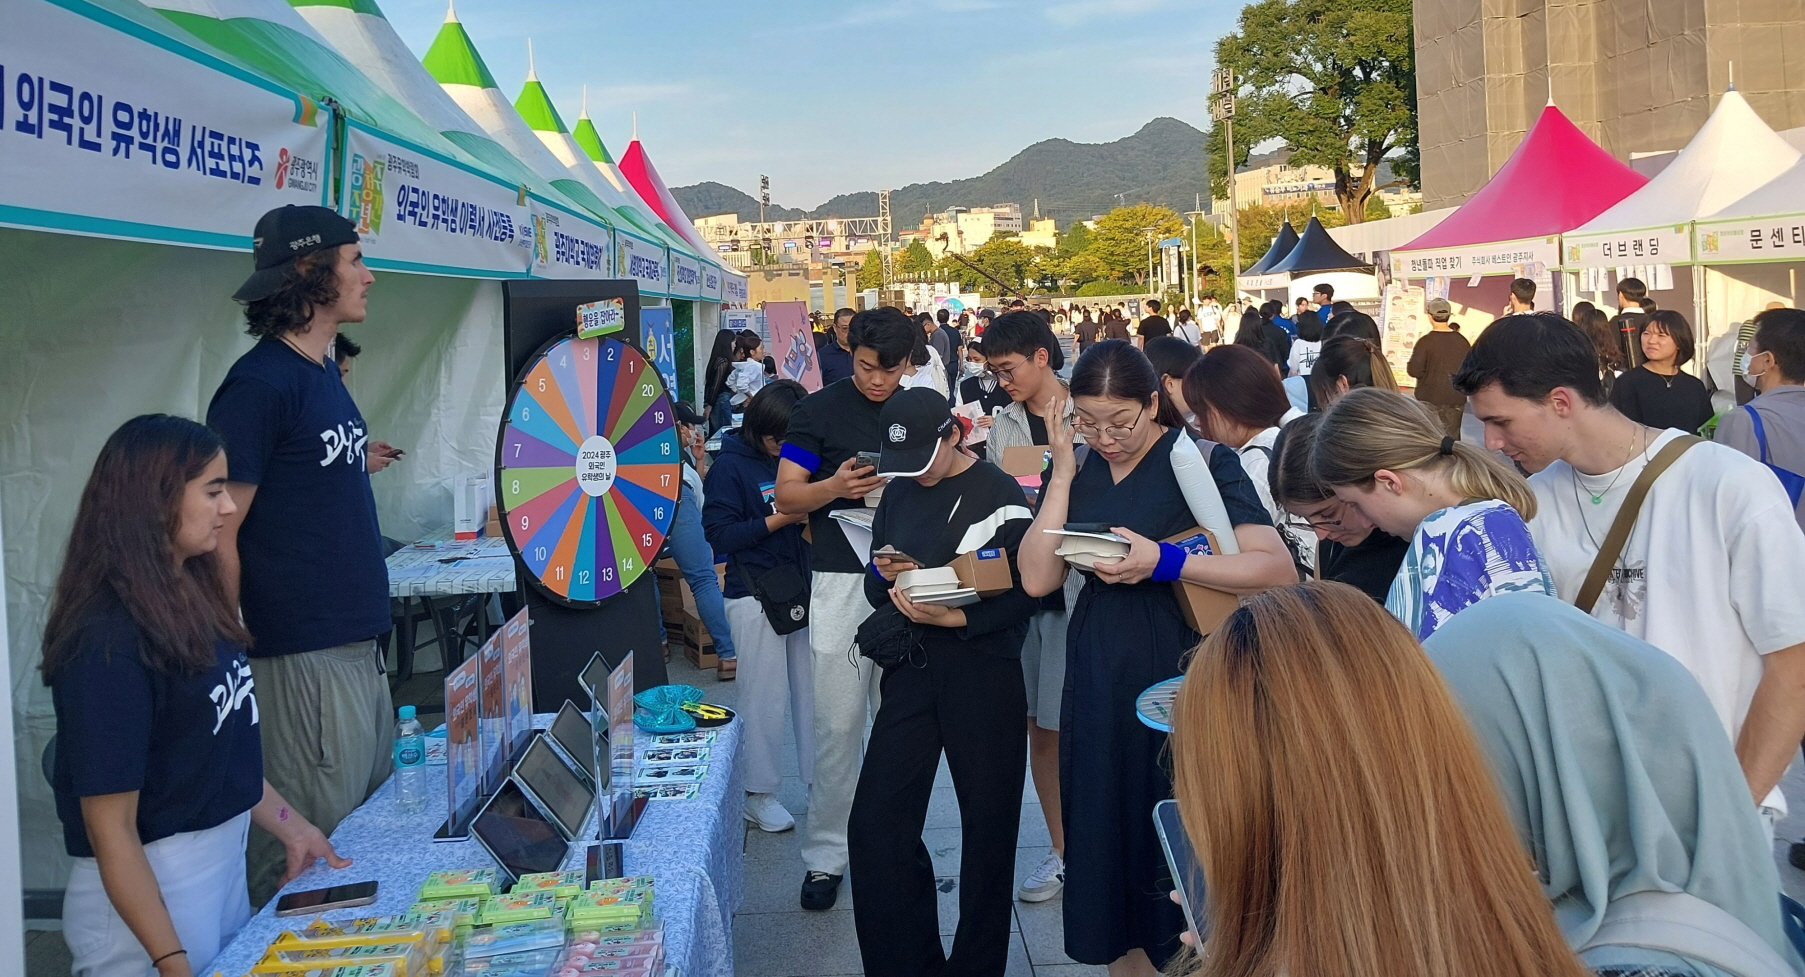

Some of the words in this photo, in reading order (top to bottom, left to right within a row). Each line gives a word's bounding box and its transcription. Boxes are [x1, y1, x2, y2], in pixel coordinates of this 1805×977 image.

[15, 72, 103, 153] 외국인
[111, 101, 182, 170] 유학생
[187, 124, 264, 186] 서포터즈
[289, 155, 319, 181] 광주광역시
[396, 184, 430, 228] 외국인
[431, 193, 458, 234] 유학생
[459, 201, 485, 239] 이력서
[485, 208, 515, 244] 사전등록
[289, 234, 322, 250] 광주은행
[1602, 237, 1660, 259] 더브랜딩
[1411, 258, 1433, 272] 청년돌파
[1435, 257, 1447, 270] 직업
[1449, 256, 1462, 270] 찾기
[1471, 255, 1491, 266] 주식회사
[1512, 251, 1534, 263] 광주지사
[583, 311, 599, 328] 행운을
[583, 348, 590, 360] 3
[607, 348, 614, 361] 2
[560, 356, 567, 368] 4
[629, 361, 634, 373] 1
[539, 379, 546, 391] 5
[642, 384, 655, 397] 20
[522, 408, 530, 421] 6
[654, 412, 664, 424] 19
[514, 444, 521, 458] 7
[583, 451, 599, 459] 2024
[600, 451, 611, 459] 광주
[660, 443, 671, 455] 18
[589, 462, 605, 470] 외국인
[582, 472, 604, 481] 유학생의
[605, 472, 611, 480] 날
[660, 474, 671, 487] 17
[512, 481, 520, 494] 8
[654, 508, 664, 520] 16
[521, 517, 529, 530] 9
[642, 534, 653, 546] 15
[535, 547, 547, 561] 10
[622, 559, 633, 571] 14
[556, 566, 564, 580] 11
[579, 571, 590, 584] 12
[602, 568, 613, 581] 13
